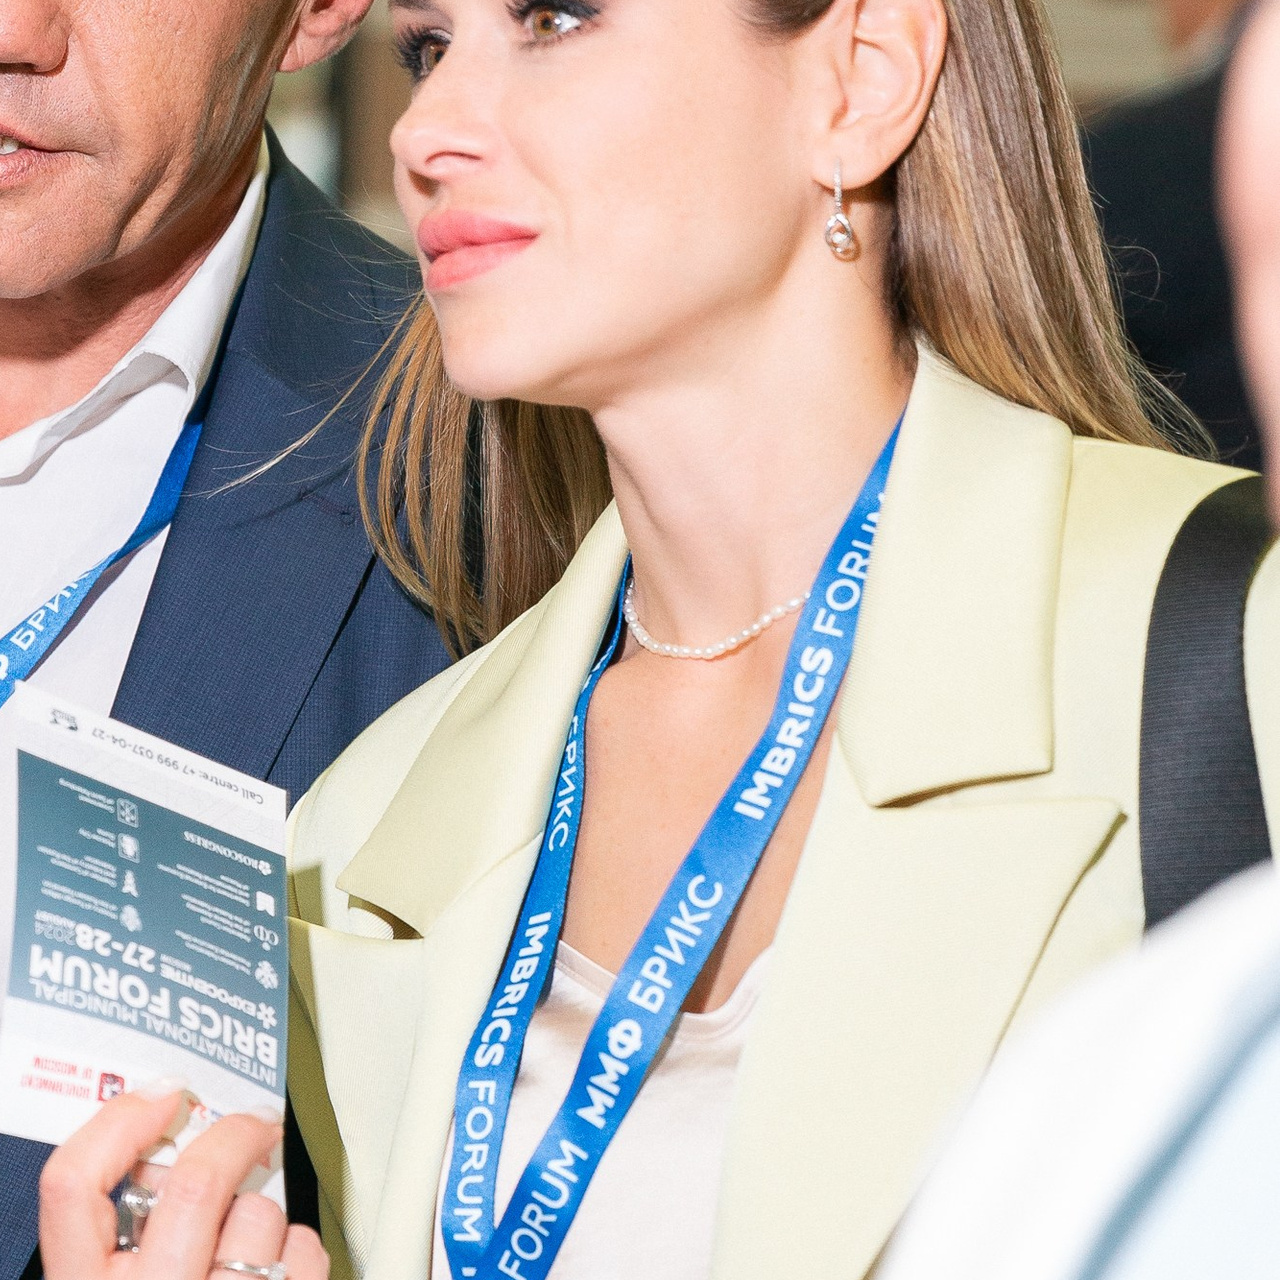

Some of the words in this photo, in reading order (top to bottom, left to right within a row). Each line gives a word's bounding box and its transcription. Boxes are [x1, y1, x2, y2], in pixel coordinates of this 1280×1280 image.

[734, 645, 834, 821] IMBRICS
[28, 944, 171, 1019] FORUM
[74, 923, 156, 972] 27-28
[28, 978, 138, 1024] MUNICIPAL
[474, 912, 552, 1068] IMBRICS
[576, 1018, 643, 1130] ММФ
[627, 874, 723, 1014] БРИКС
[142, 1014, 276, 1088] INTERNATIONAL
[178, 996, 277, 1069] BRICS
[452, 1080, 497, 1243] FORUM
